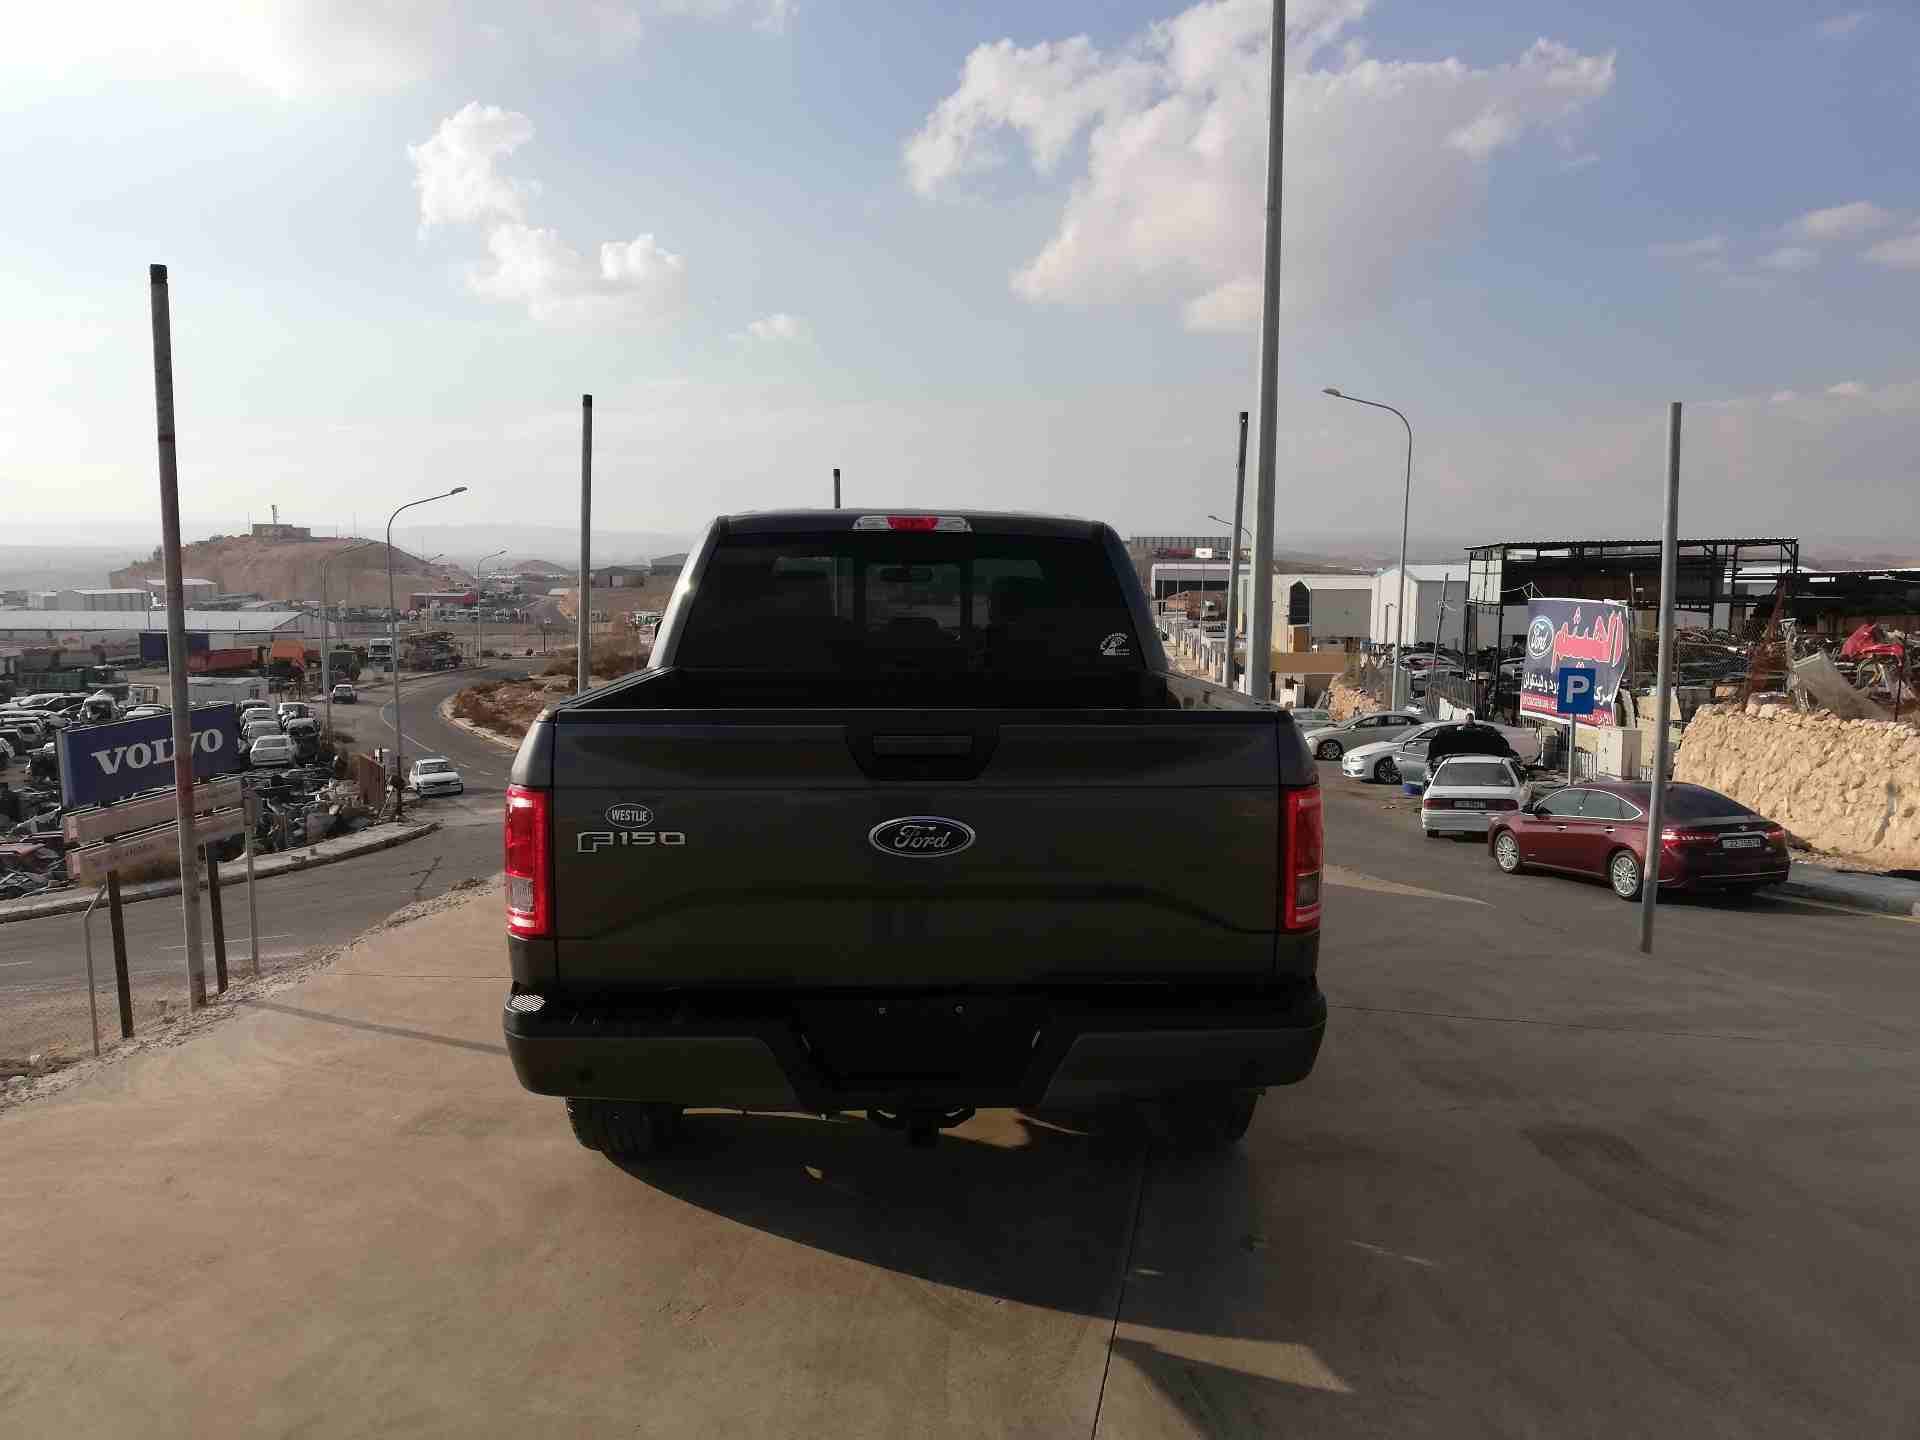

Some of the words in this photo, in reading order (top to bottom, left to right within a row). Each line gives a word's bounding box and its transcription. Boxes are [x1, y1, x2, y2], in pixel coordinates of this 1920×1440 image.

[1566, 675, 1590, 703] P
[611, 809, 649, 822] WESTLIE
[894, 825, 951, 848] Ford
